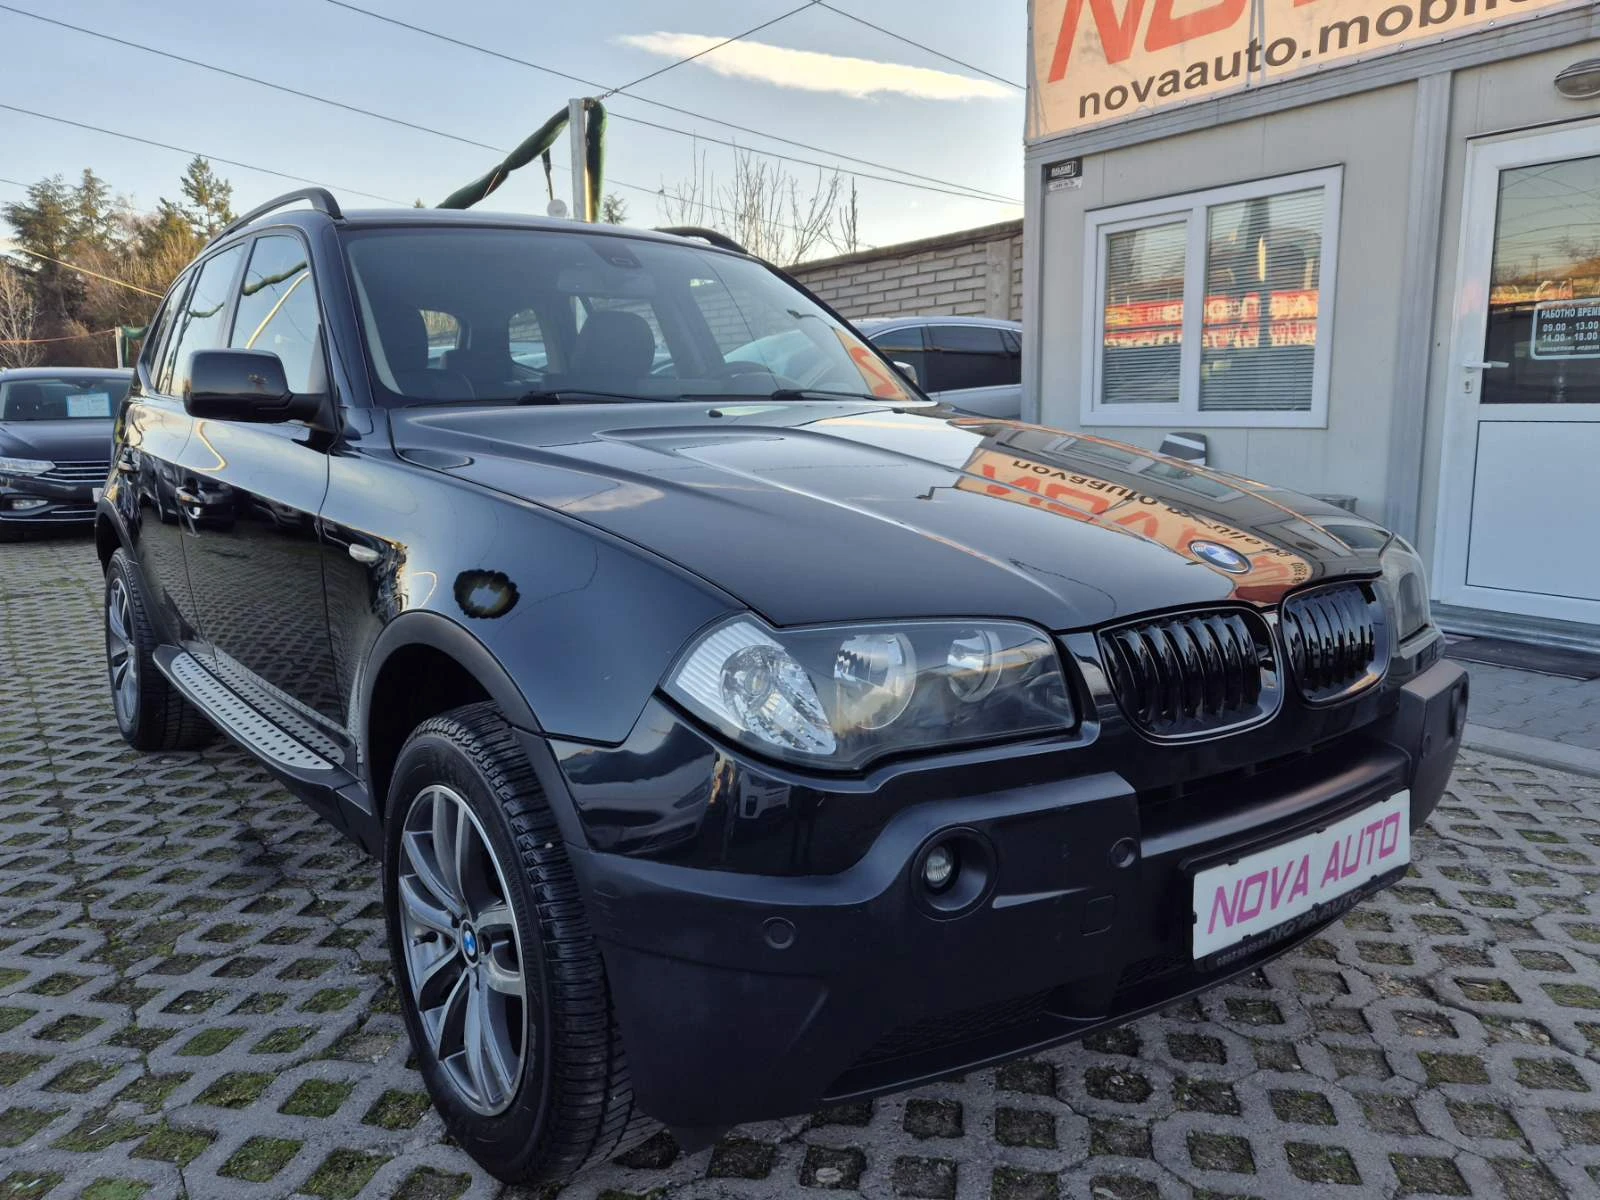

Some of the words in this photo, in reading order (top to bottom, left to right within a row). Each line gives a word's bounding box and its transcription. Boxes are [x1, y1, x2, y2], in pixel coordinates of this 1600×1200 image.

[1079, 0, 1527, 118] novaauto.mob
[1541, 308, 1576, 319] РАБОТНО
[1543, 322, 1566, 332] 09.00
[1576, 321, 1599, 330] 13.00
[1543, 333, 1566, 342] 14.00
[1575, 332, 1598, 341] 18.00
[1207, 854, 1310, 934] NOVA
[1320, 812, 1400, 888] AUTO
